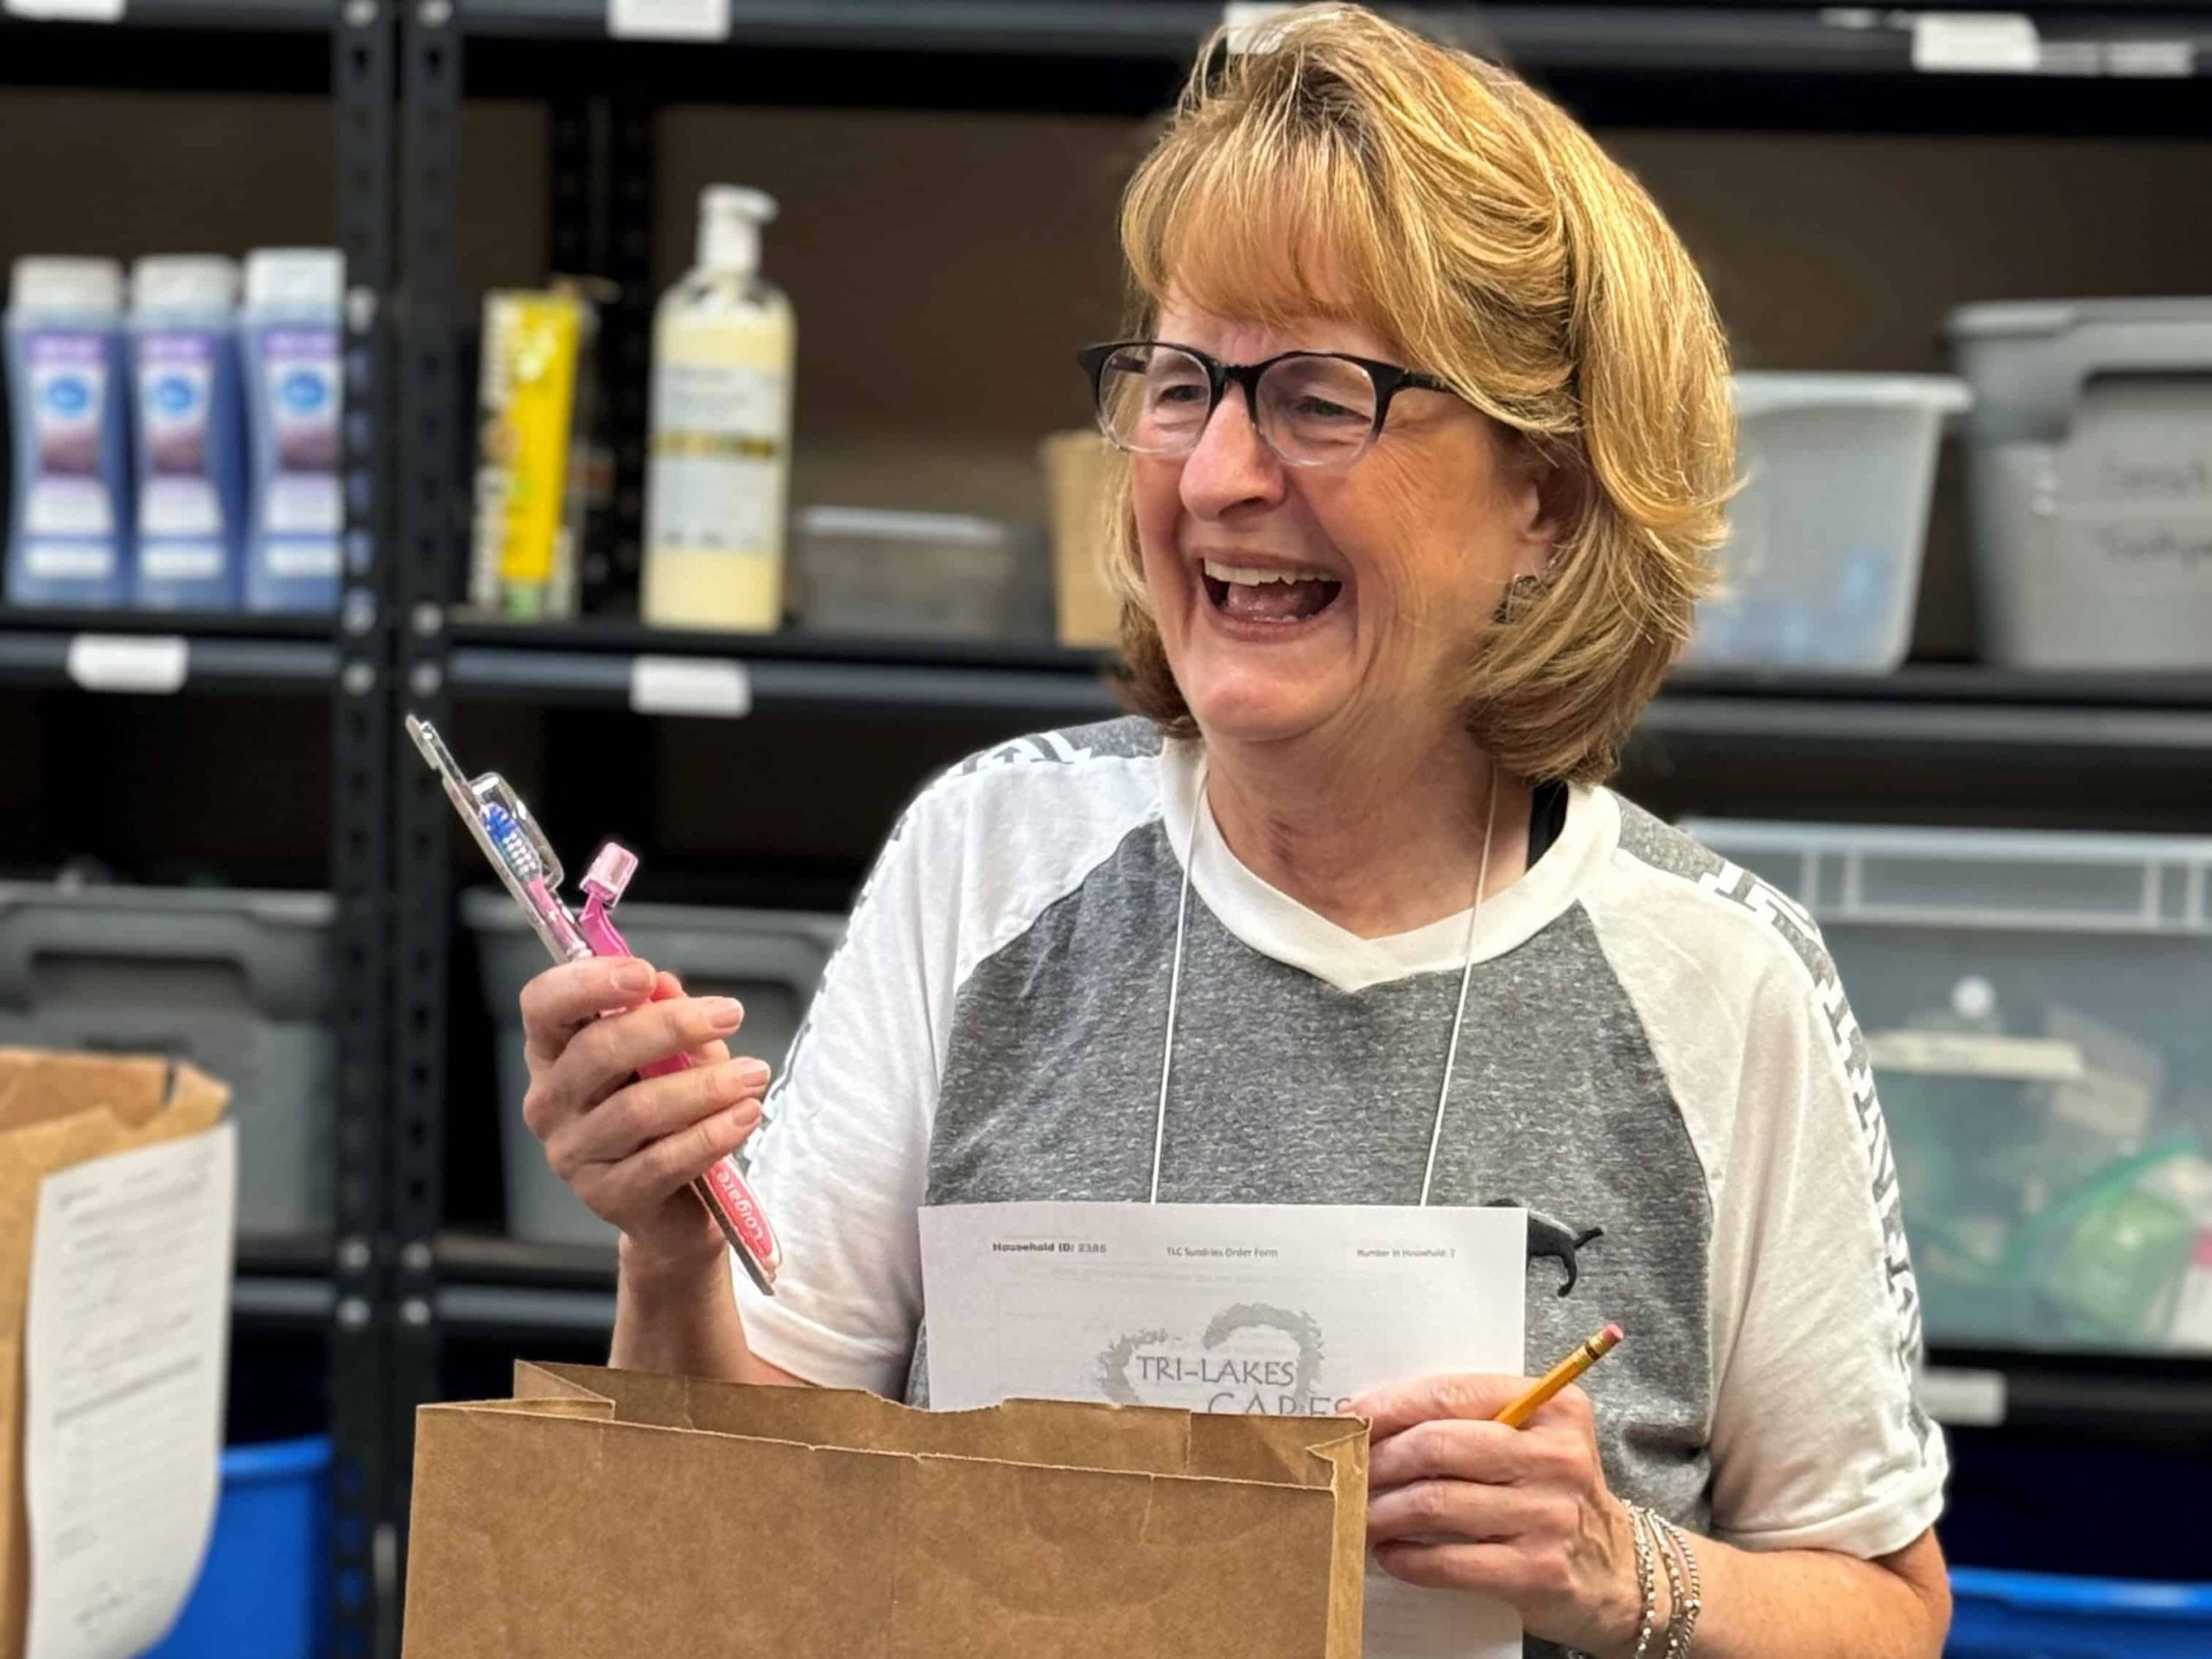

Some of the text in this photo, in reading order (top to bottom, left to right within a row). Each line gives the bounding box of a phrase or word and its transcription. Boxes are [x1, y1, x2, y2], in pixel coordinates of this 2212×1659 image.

[992, 1242, 1054, 1252] Household
[1058, 1243, 1074, 1253] ID:
[1166, 1247, 1184, 1256] TLC
[1185, 1247, 1224, 1257] Sundries
[1225, 1248, 1252, 1257] Order
[1135, 1355, 1295, 1387] TRI-LAKES
